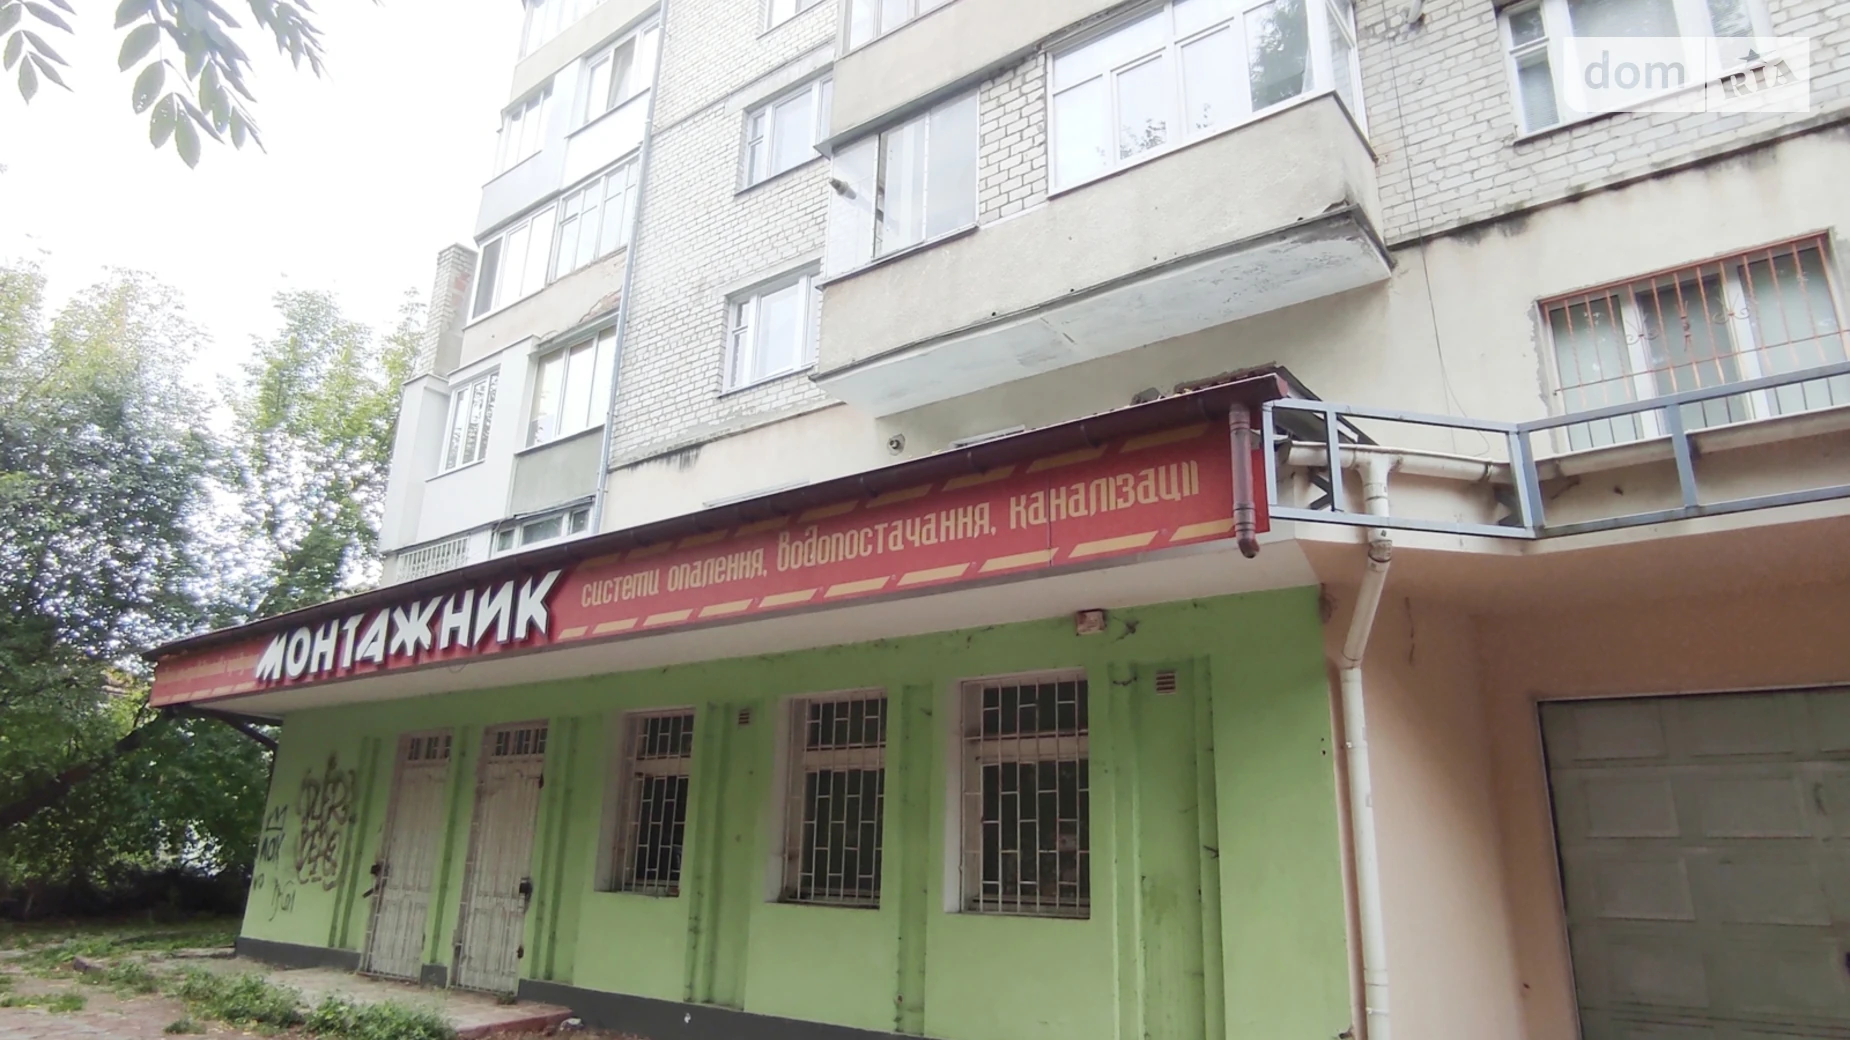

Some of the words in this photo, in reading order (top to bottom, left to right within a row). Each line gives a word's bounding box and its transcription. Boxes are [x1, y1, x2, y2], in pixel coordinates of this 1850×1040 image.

[581, 568, 661, 608] системи
[667, 547, 768, 592] опалення,
[255, 569, 563, 682] МОНТАЖНИК
